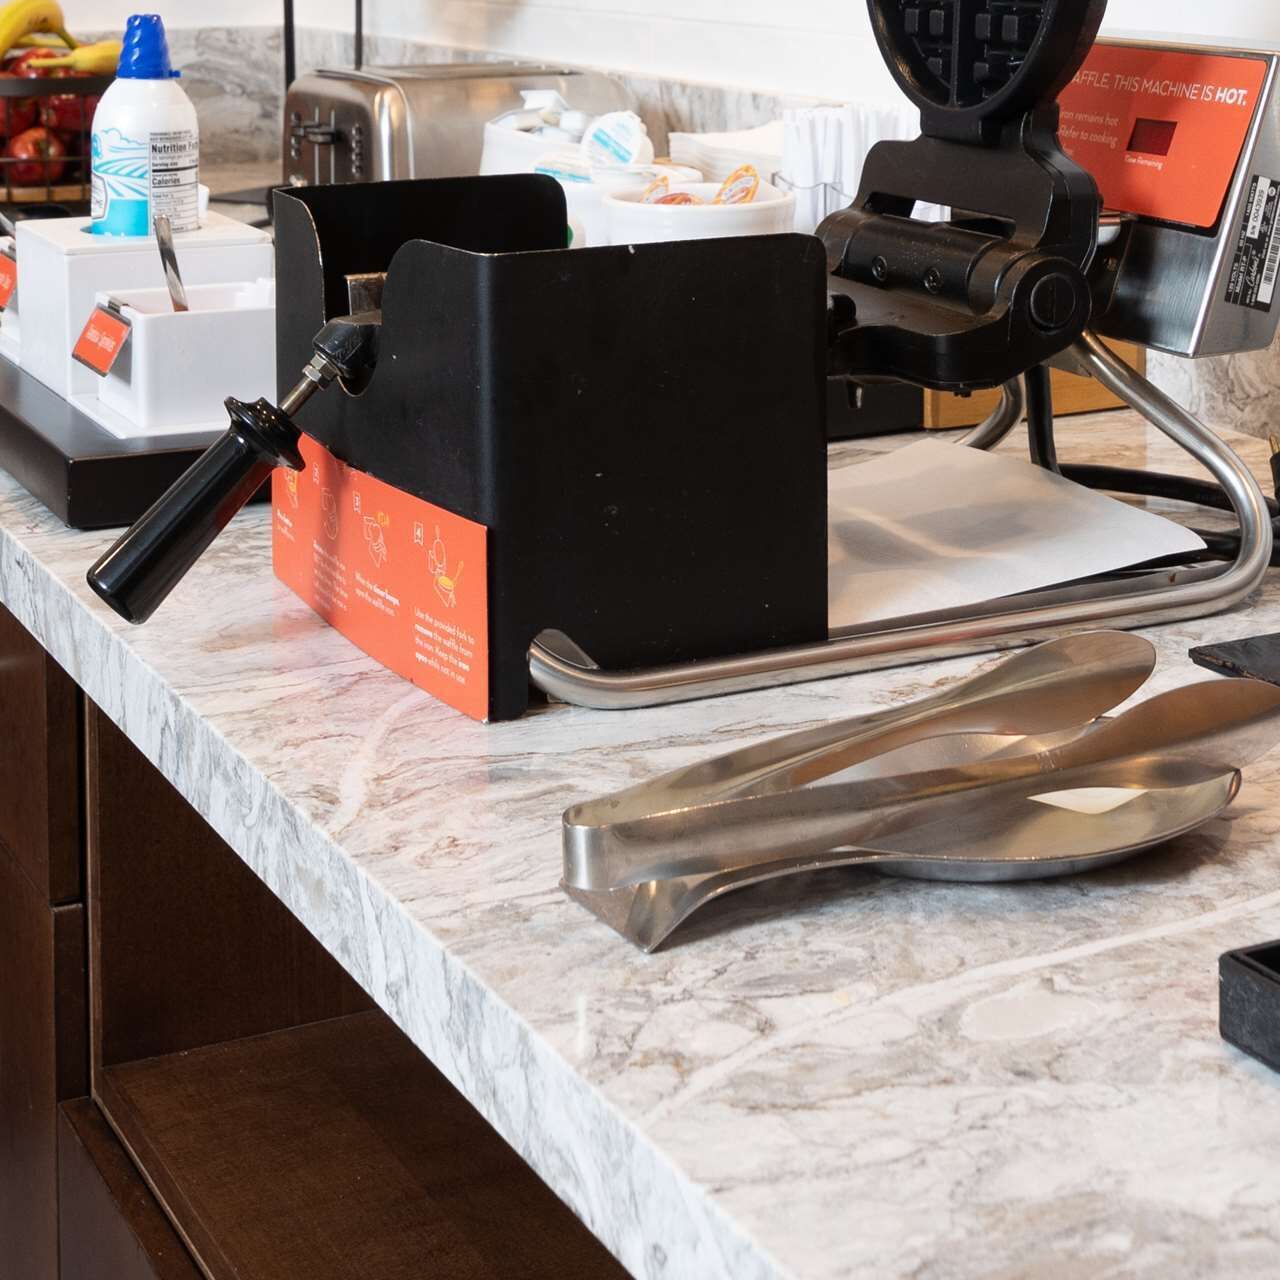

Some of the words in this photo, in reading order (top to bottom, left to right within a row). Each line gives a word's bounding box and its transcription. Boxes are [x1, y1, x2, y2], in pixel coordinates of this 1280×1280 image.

[1113, 74, 1141, 93] THIS
[1140, 79, 1200, 100] MACHINE
[1201, 85, 1214, 101] IS
[1215, 86, 1248, 107] HOT.
[151, 143, 187, 154] Nutrition
[151, 176, 180, 186] Calories
